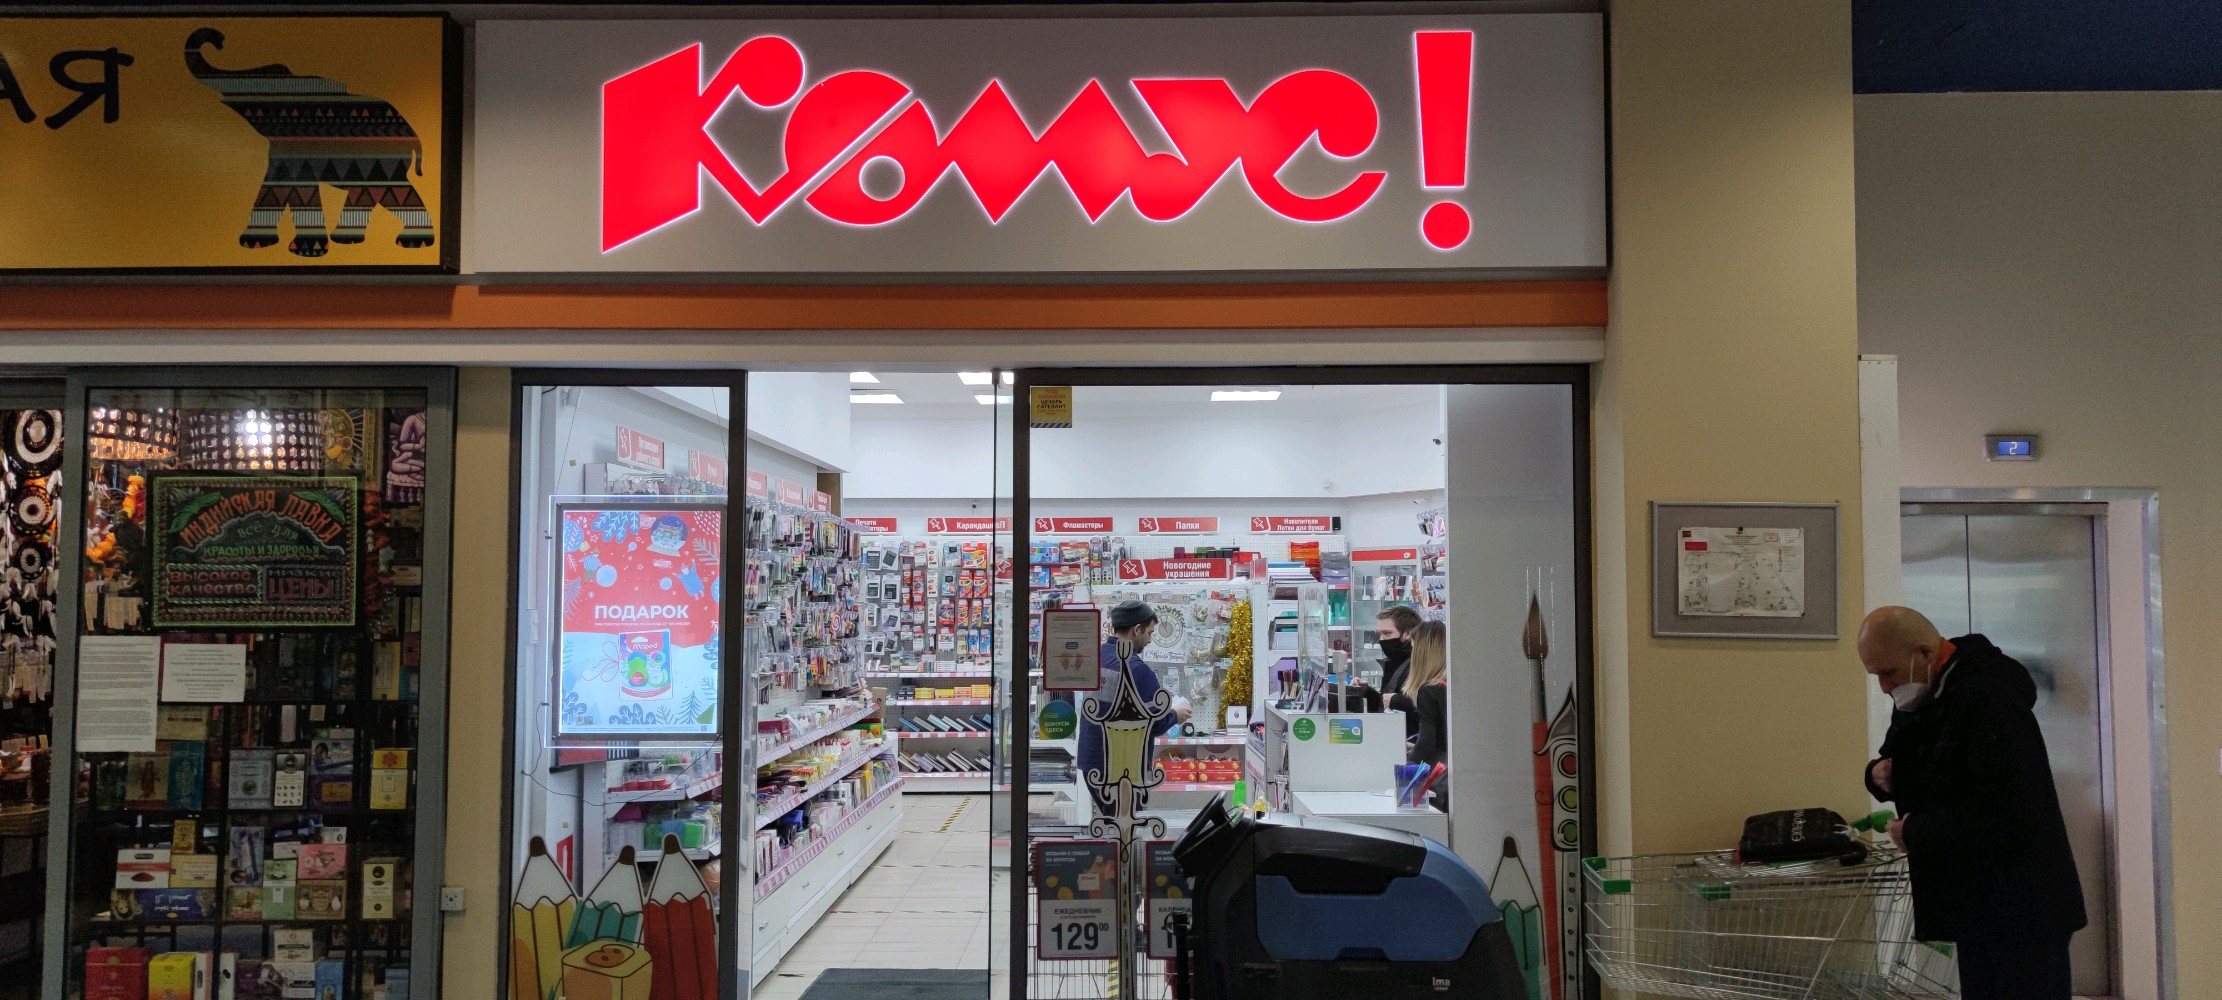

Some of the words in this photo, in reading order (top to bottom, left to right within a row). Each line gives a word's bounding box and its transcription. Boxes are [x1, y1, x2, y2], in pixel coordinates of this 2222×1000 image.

[2009, 441, 2018, 455] 2
[179, 489, 276, 549] ИНДИЙСКАЯ
[278, 493, 343, 544] ЛАВКА
[1063, 521, 1104, 530] Фломастеры
[1175, 521, 1200, 530] Папки
[203, 546, 255, 556] КРАСОТЫ
[267, 544, 321, 556] ЗДОРОВЬЯ
[1163, 561, 1212, 570] Новогодние
[1165, 570, 1210, 579] украшения
[268, 577, 335, 600] ЦЕНЫ
[594, 604, 689, 622] ПОДАРОК
[1051, 922, 1099, 951] 129
